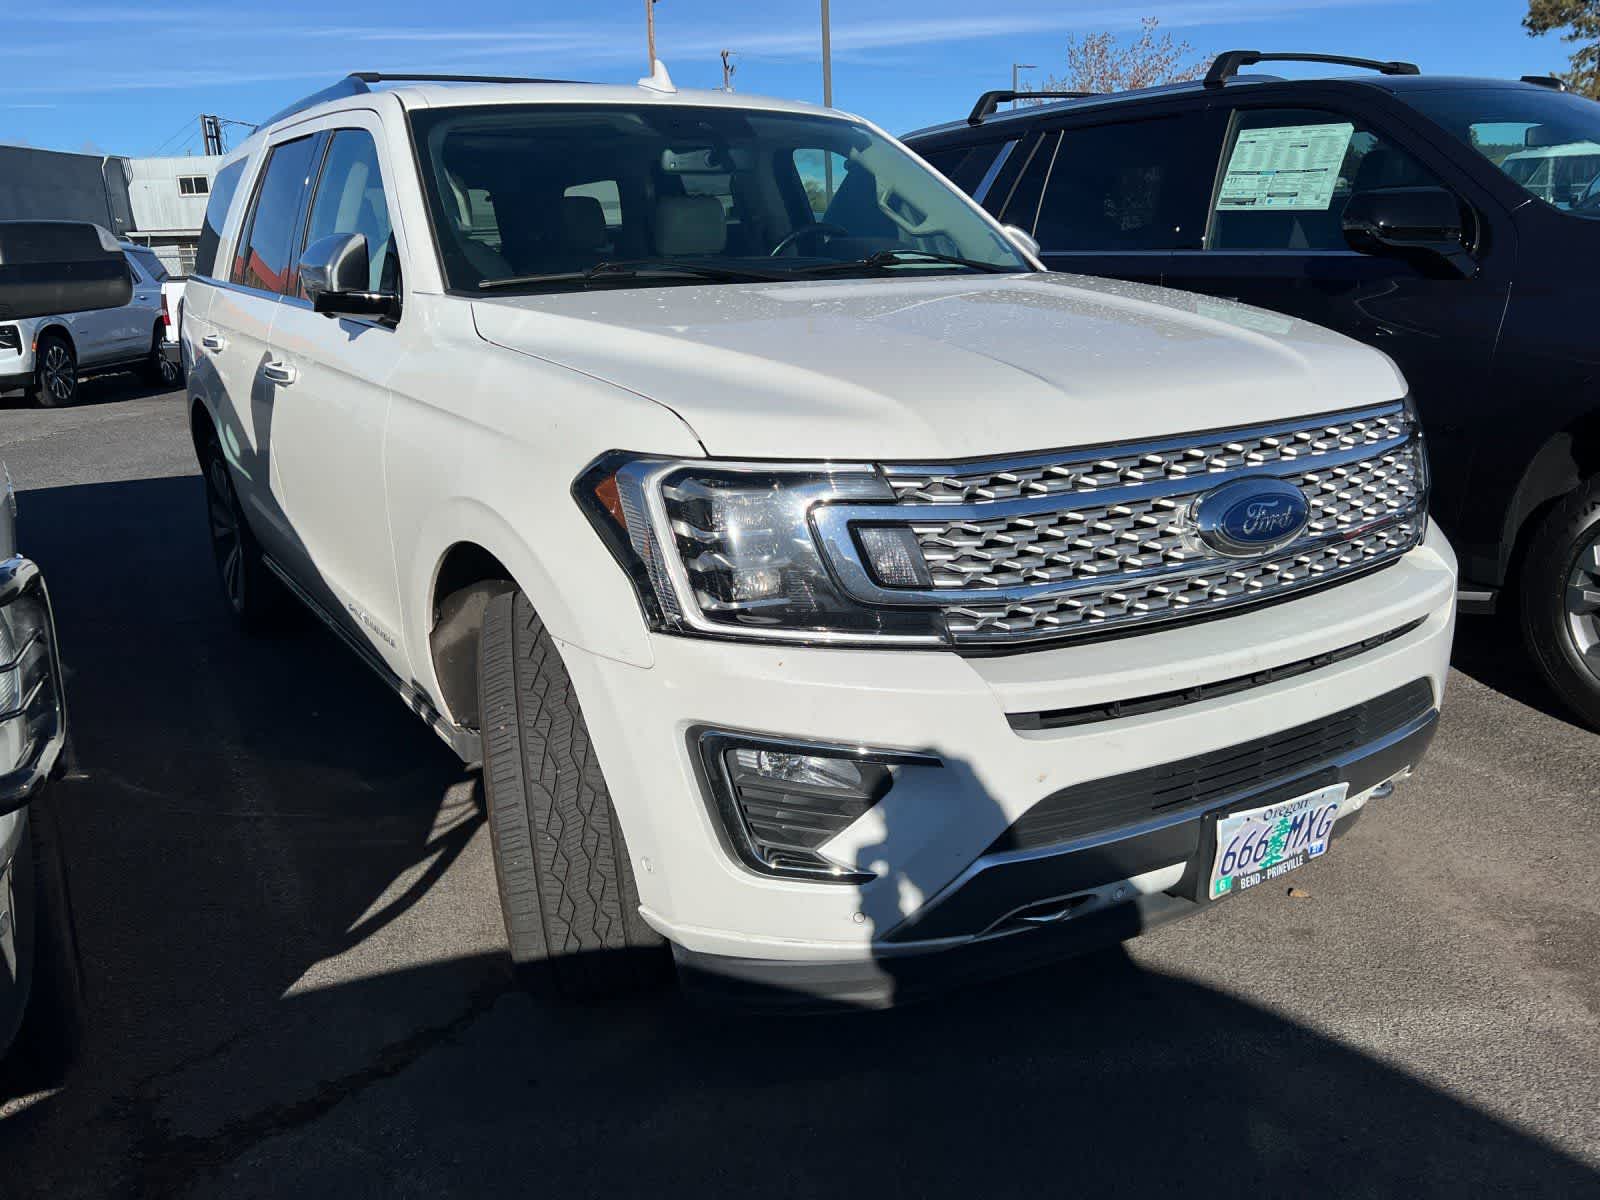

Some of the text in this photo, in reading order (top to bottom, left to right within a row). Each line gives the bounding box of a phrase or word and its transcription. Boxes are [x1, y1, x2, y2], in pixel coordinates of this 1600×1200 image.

[1242, 500, 1293, 535] Ford
[1263, 799, 1309, 821] Oregon
[1220, 803, 1338, 875] 666 MXG
[1240, 873, 1261, 889] BEND
[1267, 855, 1304, 879] PRINEVILLE
